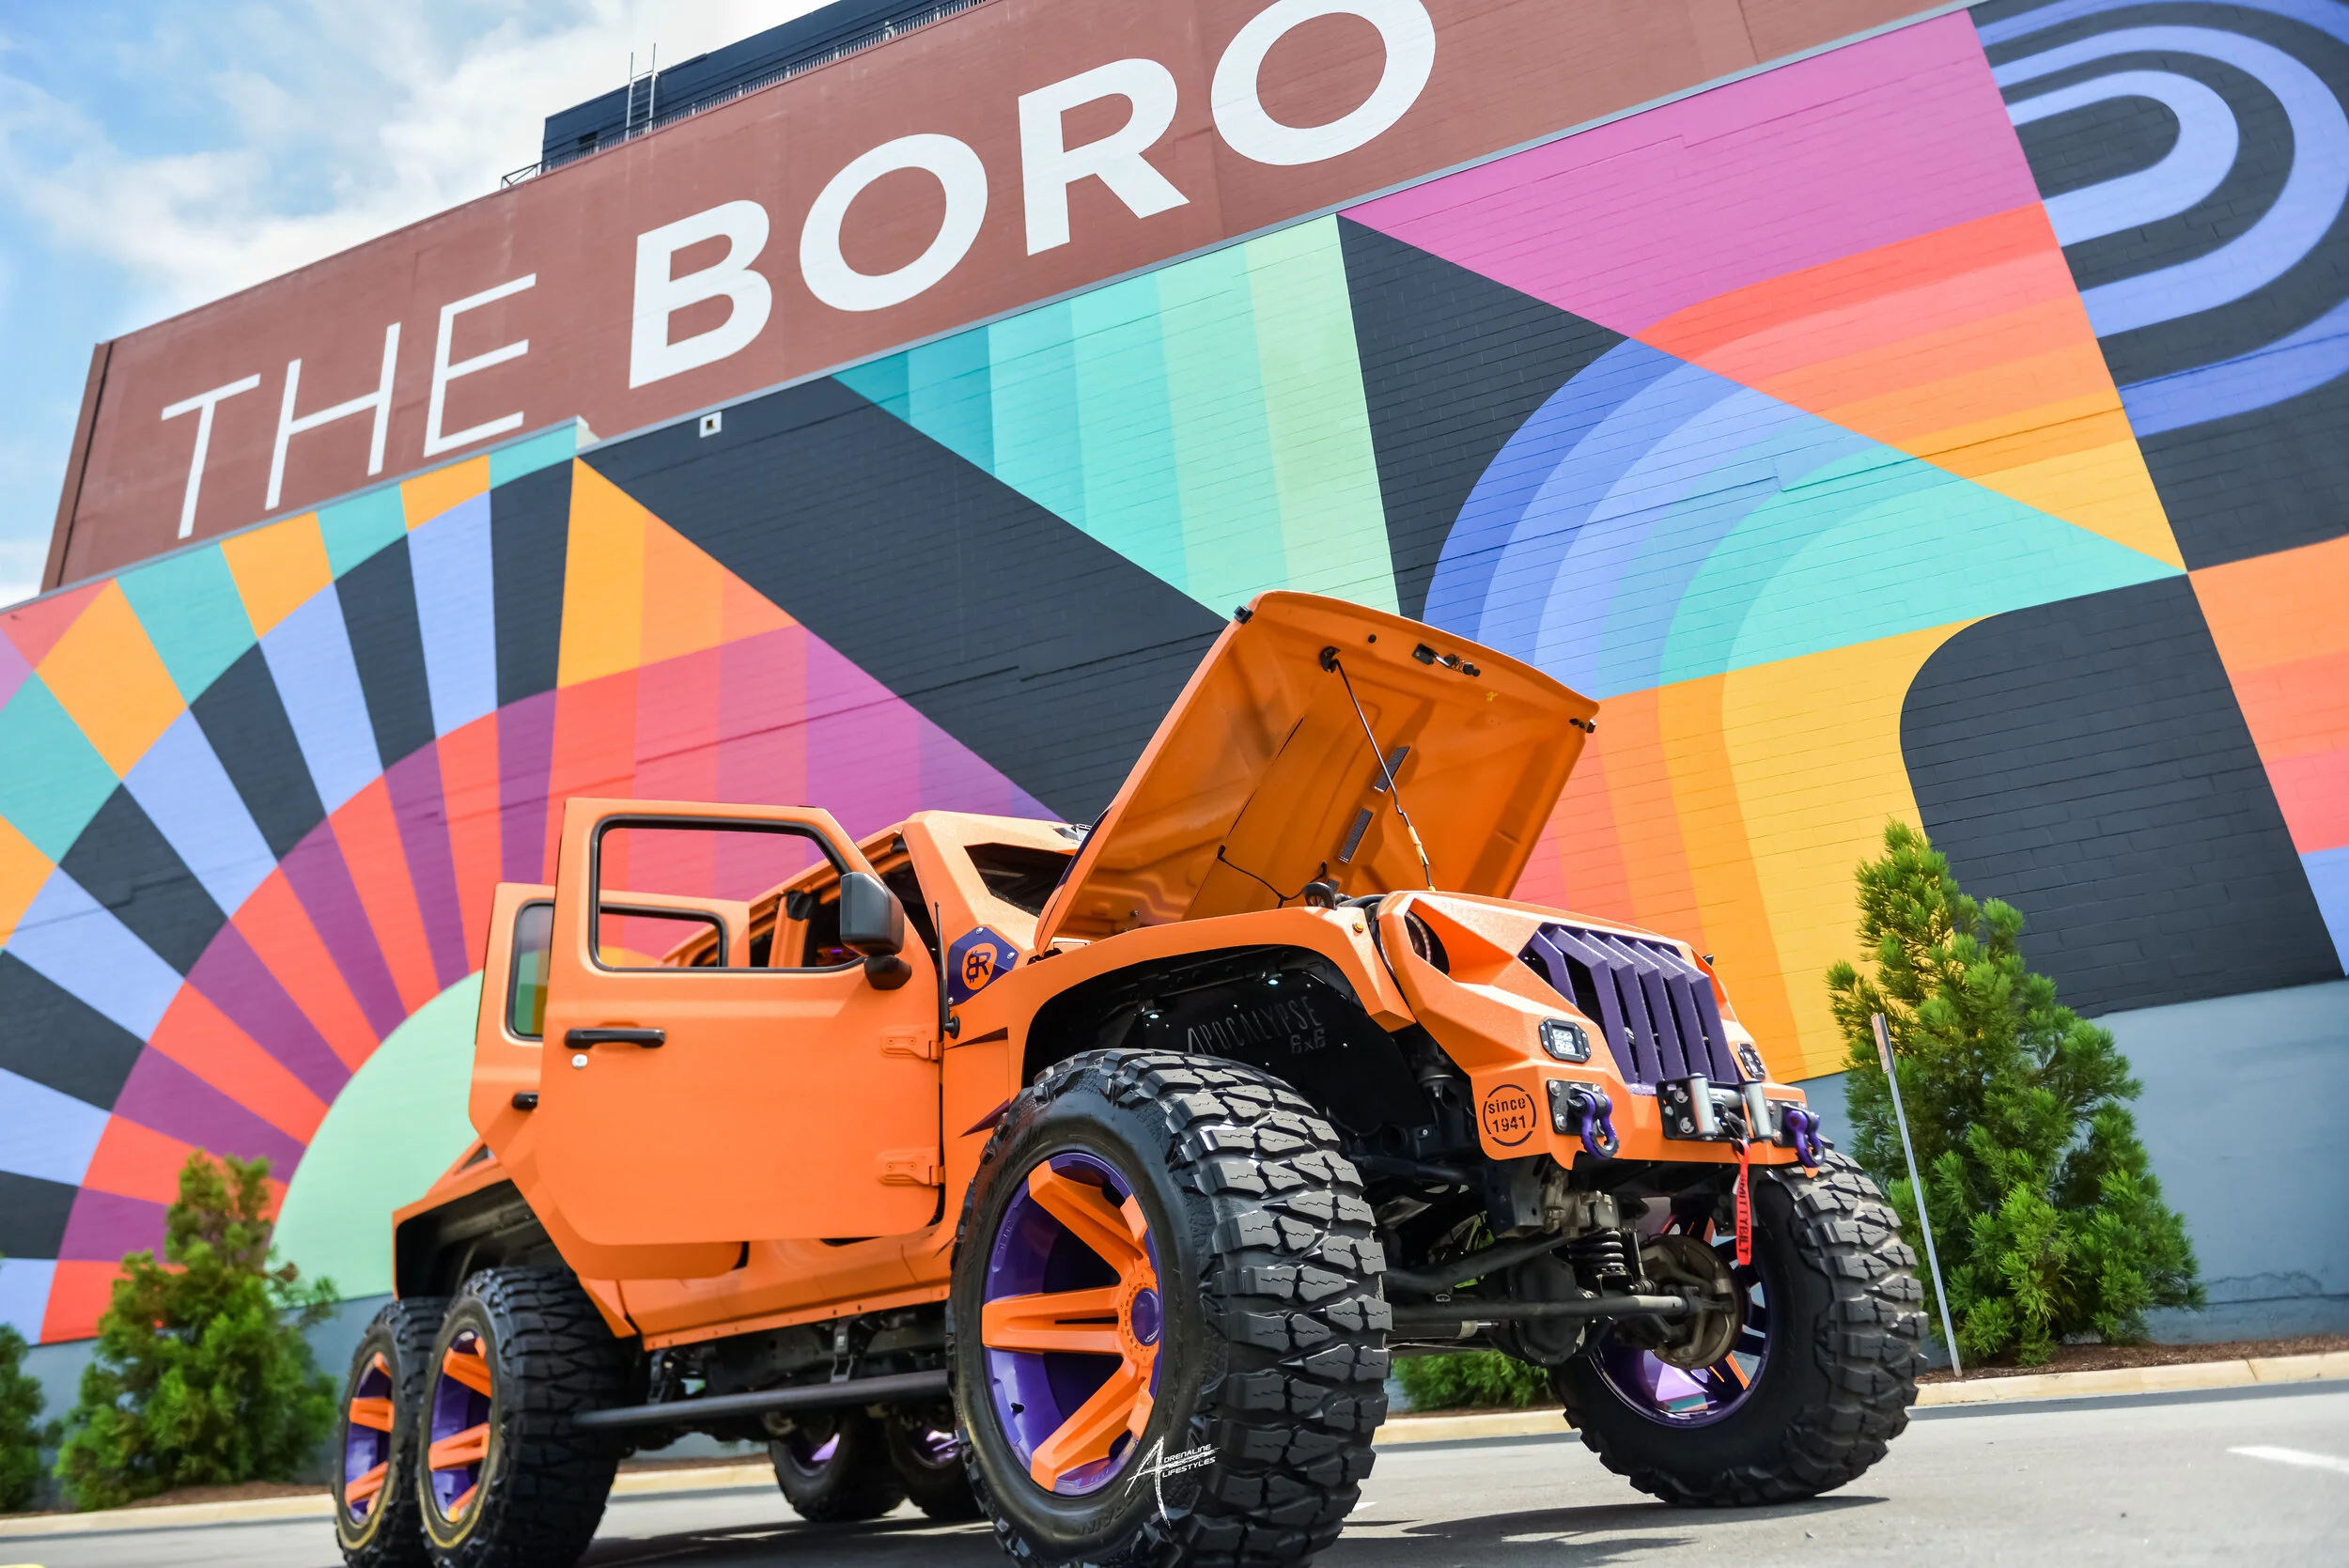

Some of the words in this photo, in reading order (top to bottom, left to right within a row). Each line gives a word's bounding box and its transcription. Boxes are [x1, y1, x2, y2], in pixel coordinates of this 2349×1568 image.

[161, 272, 537, 539] THE
[629, 0, 1437, 390] BORO
[1187, 996, 1323, 1054] APOCALYPSE
[1487, 1097, 1526, 1114] since
[1492, 1115, 1526, 1133] 1941
